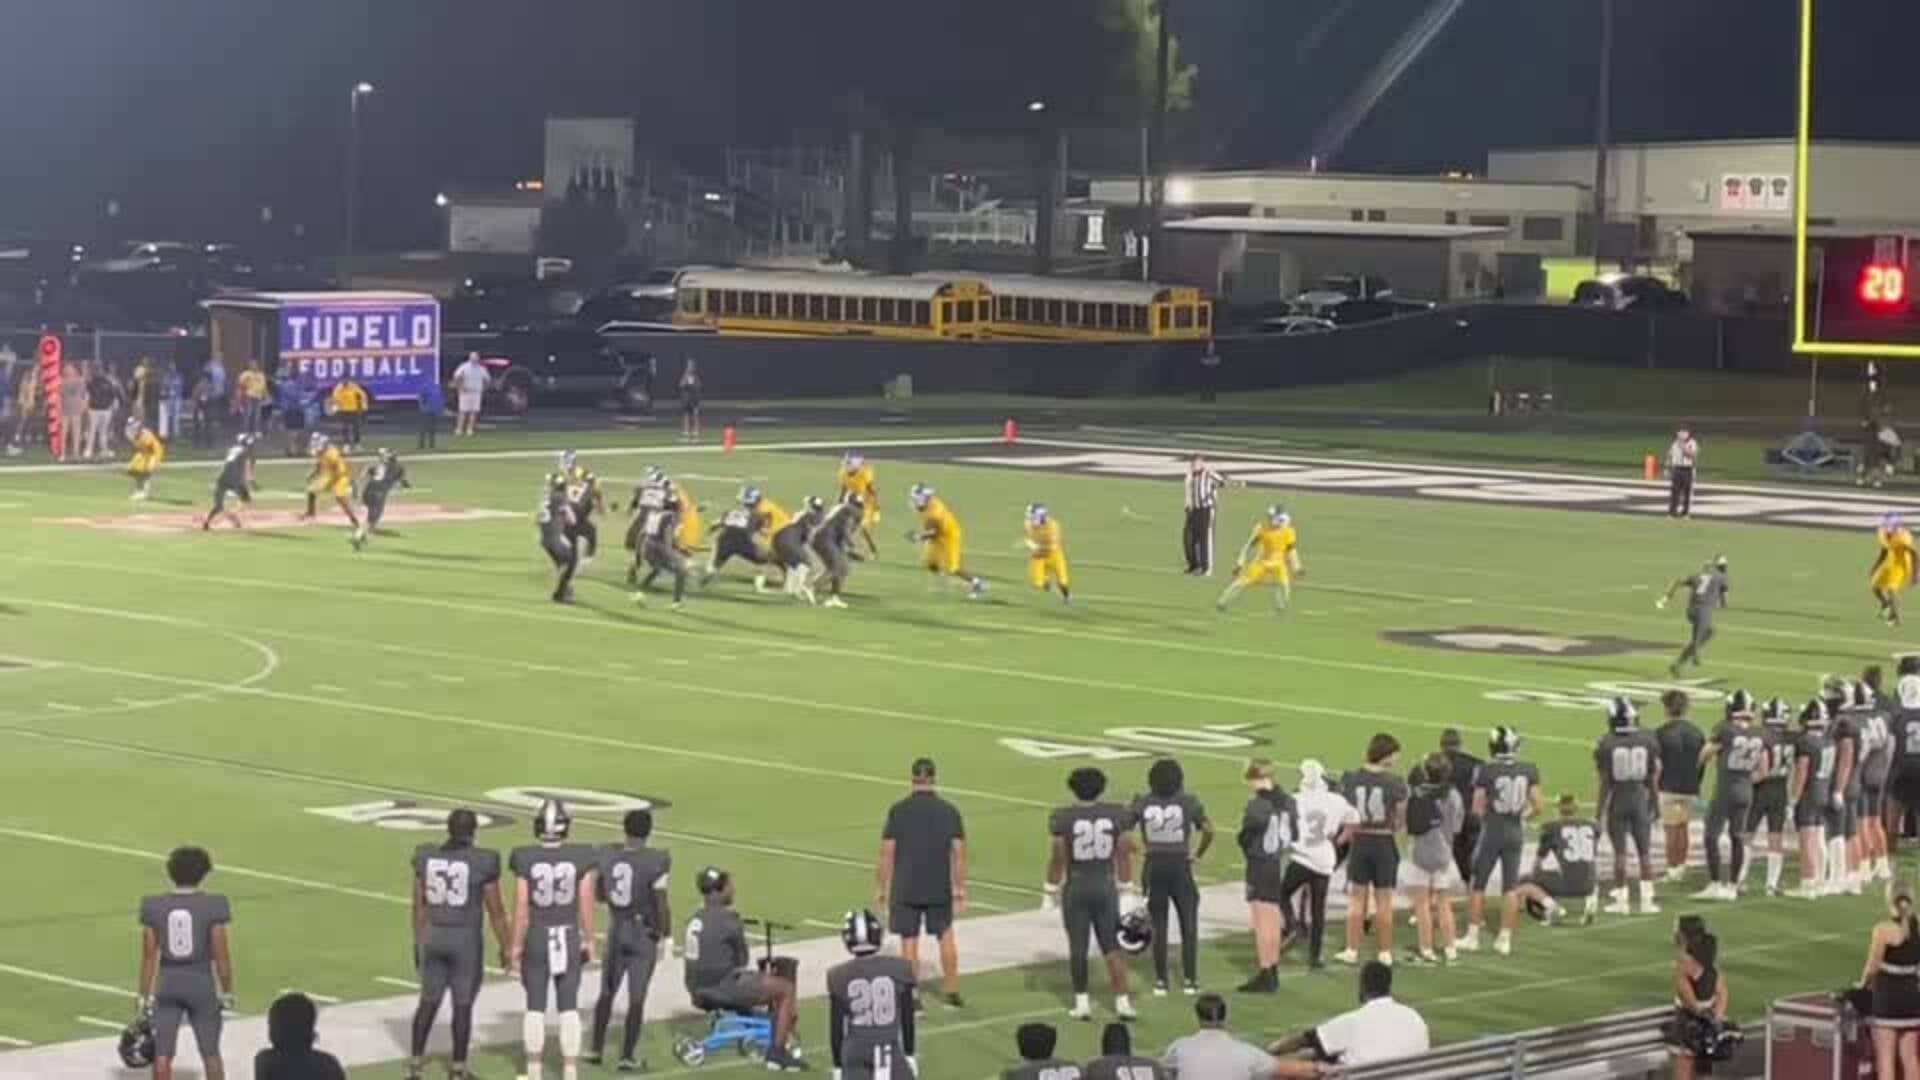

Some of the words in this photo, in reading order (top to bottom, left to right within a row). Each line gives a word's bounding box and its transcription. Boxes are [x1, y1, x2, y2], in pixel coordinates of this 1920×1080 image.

[1865, 266, 1903, 301] 20
[288, 314, 432, 349] TUPELO
[298, 357, 422, 378] FOOTBALL
[1493, 763, 1528, 815] 30
[1073, 818, 1114, 861] 26
[1143, 804, 1185, 843] 22
[425, 858, 470, 905] 53
[530, 862, 577, 907] 33
[610, 862, 634, 907] 3
[167, 908, 194, 958] 8
[848, 975, 897, 1026] 28
